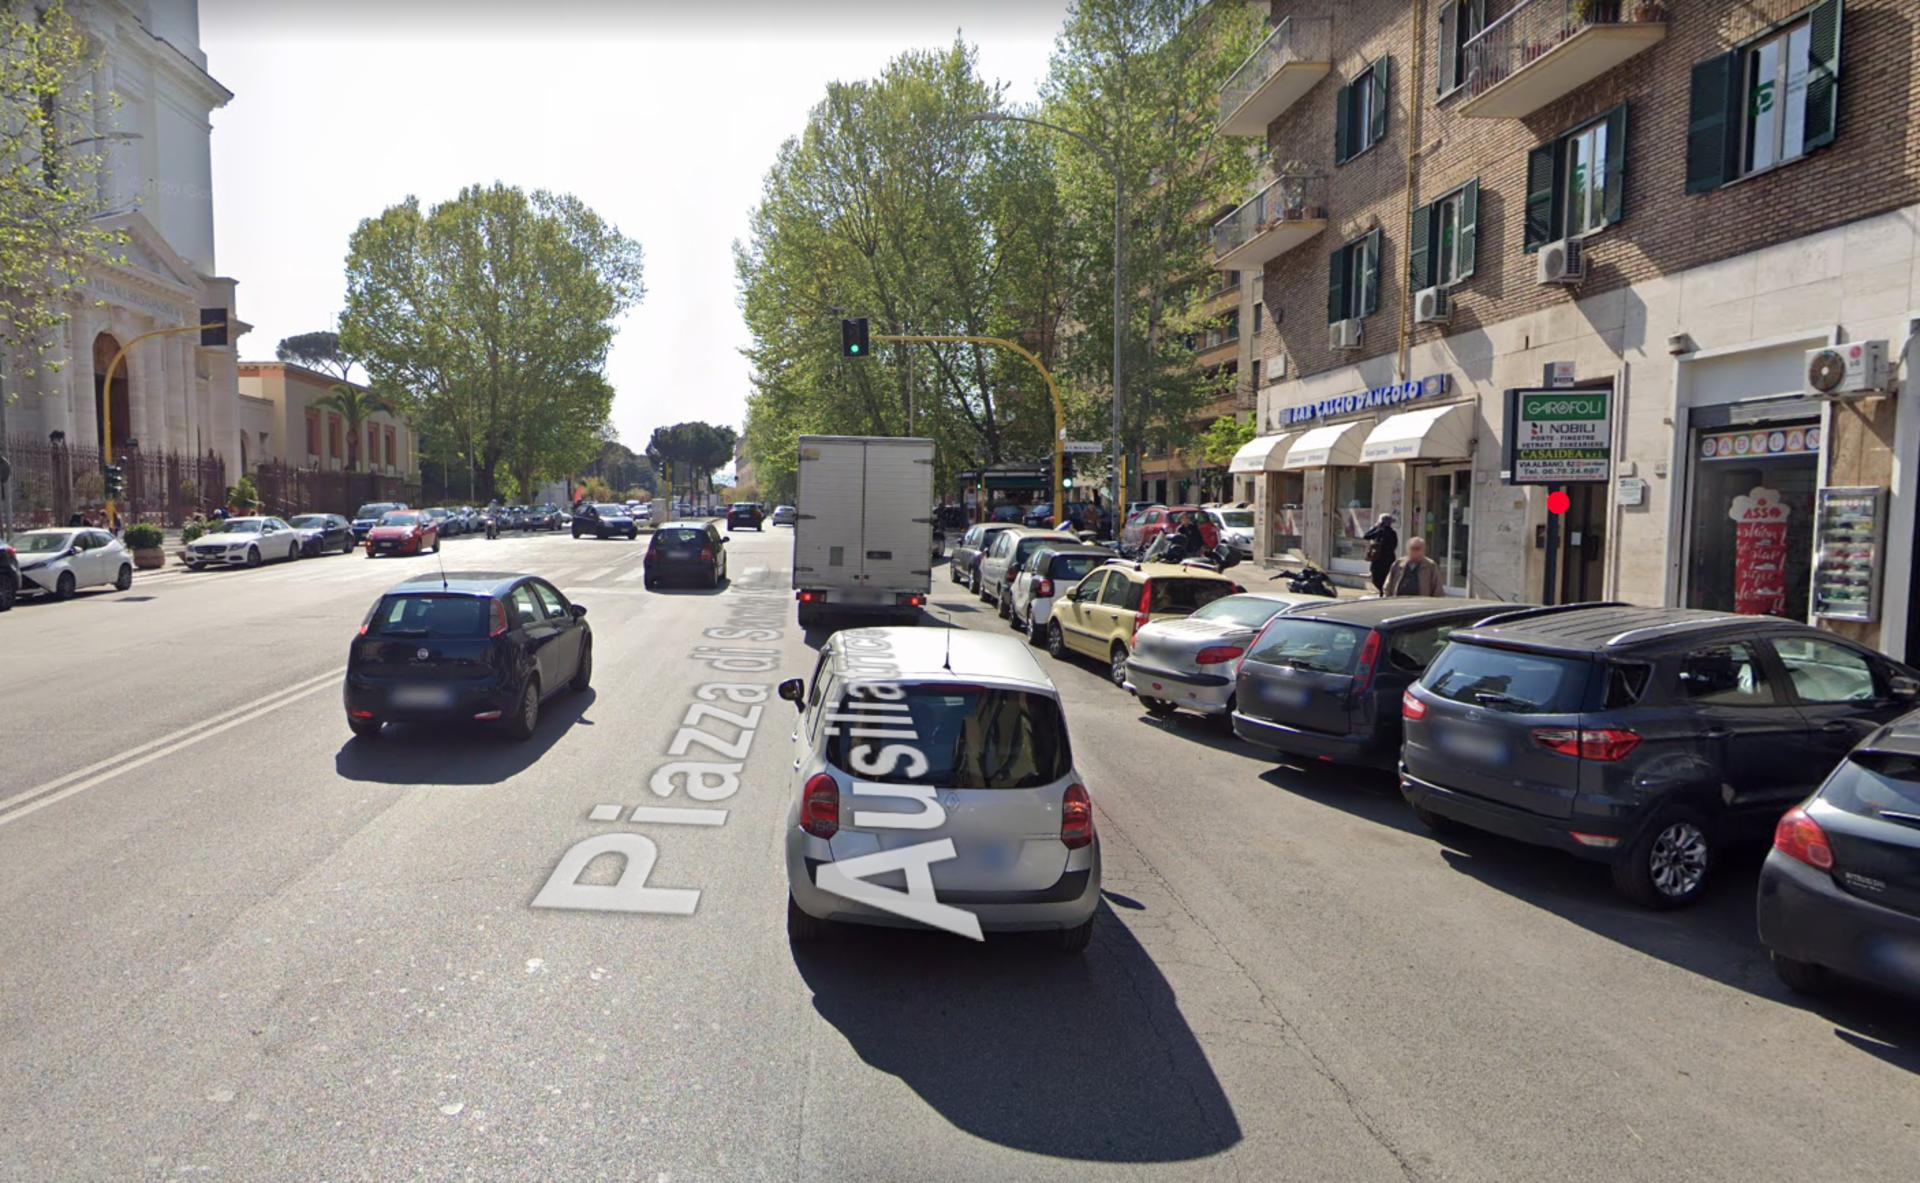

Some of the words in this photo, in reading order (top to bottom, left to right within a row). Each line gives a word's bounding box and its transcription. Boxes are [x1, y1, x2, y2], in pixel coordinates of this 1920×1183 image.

[1316, 395, 1354, 416] CALCIO
[1356, 381, 1419, 409] D'ANGOLO
[1527, 401, 1602, 415] GAROFOLI
[1549, 423, 1595, 434] NOBILI
[1520, 449, 1583, 460] CASAIDEA
